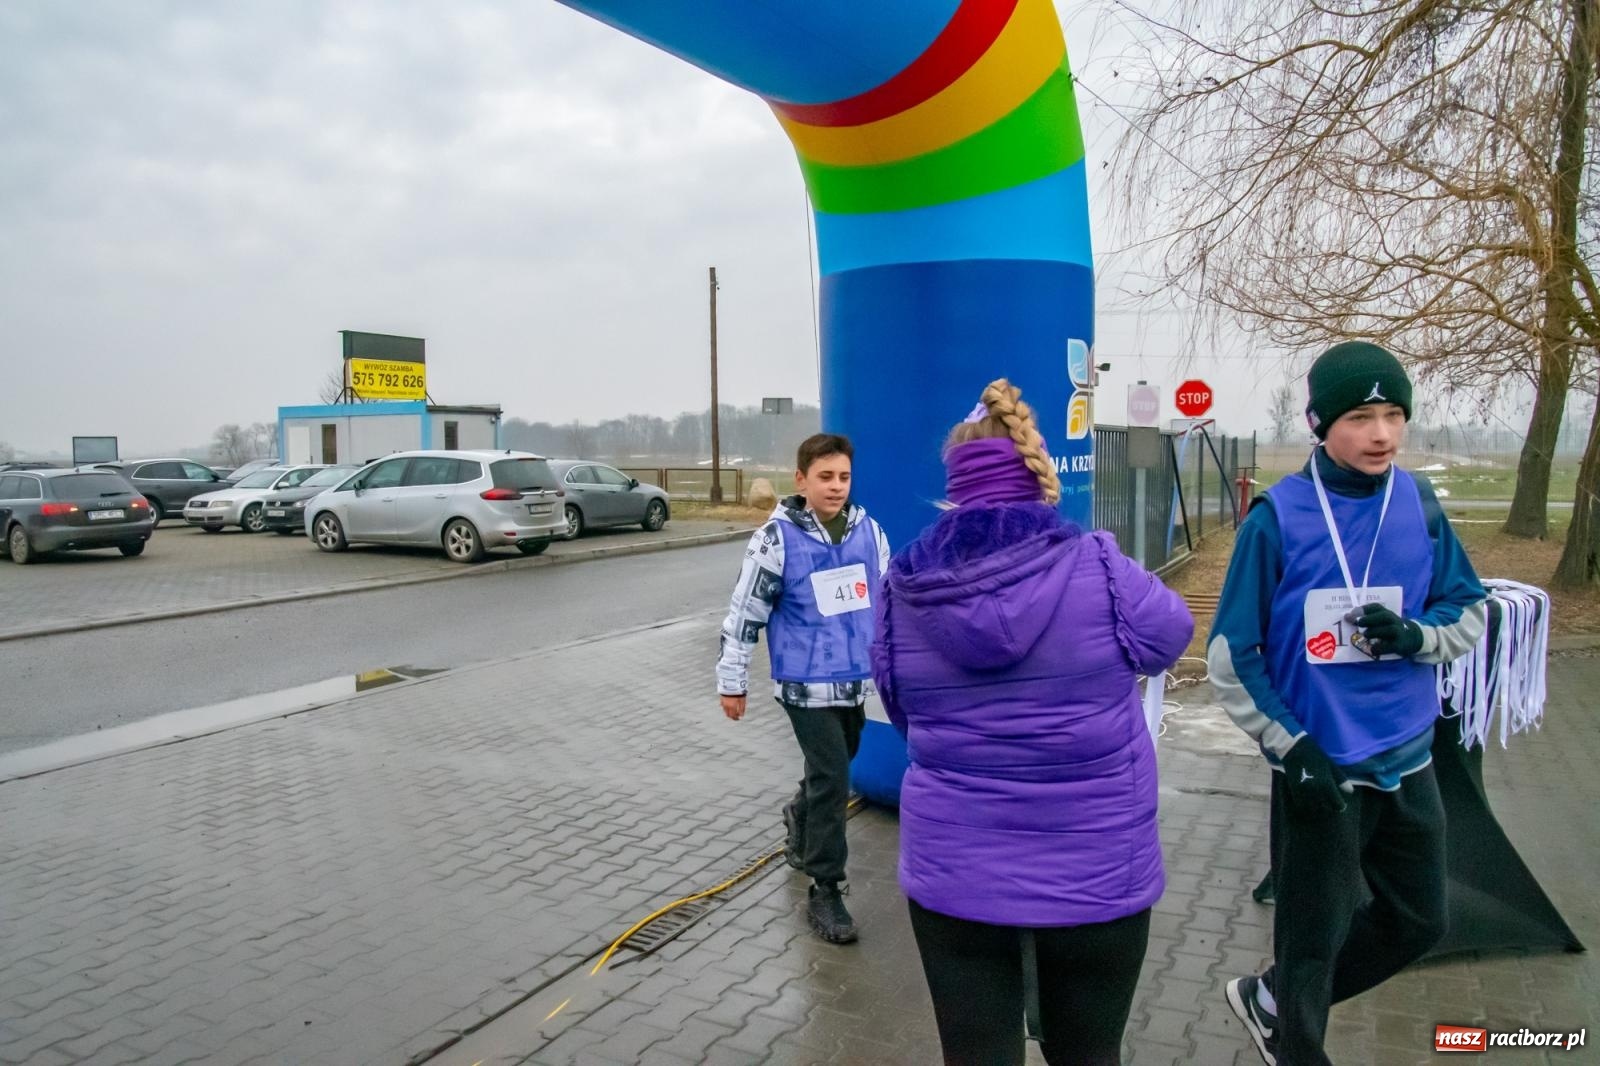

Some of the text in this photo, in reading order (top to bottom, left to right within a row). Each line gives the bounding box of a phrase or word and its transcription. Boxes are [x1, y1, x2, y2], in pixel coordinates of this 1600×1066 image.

[364, 363, 388, 371] WYWÓZ
[353, 371, 424, 388] 575 792 626
[1178, 392, 1210, 405] STOP
[835, 583, 855, 601] 41
